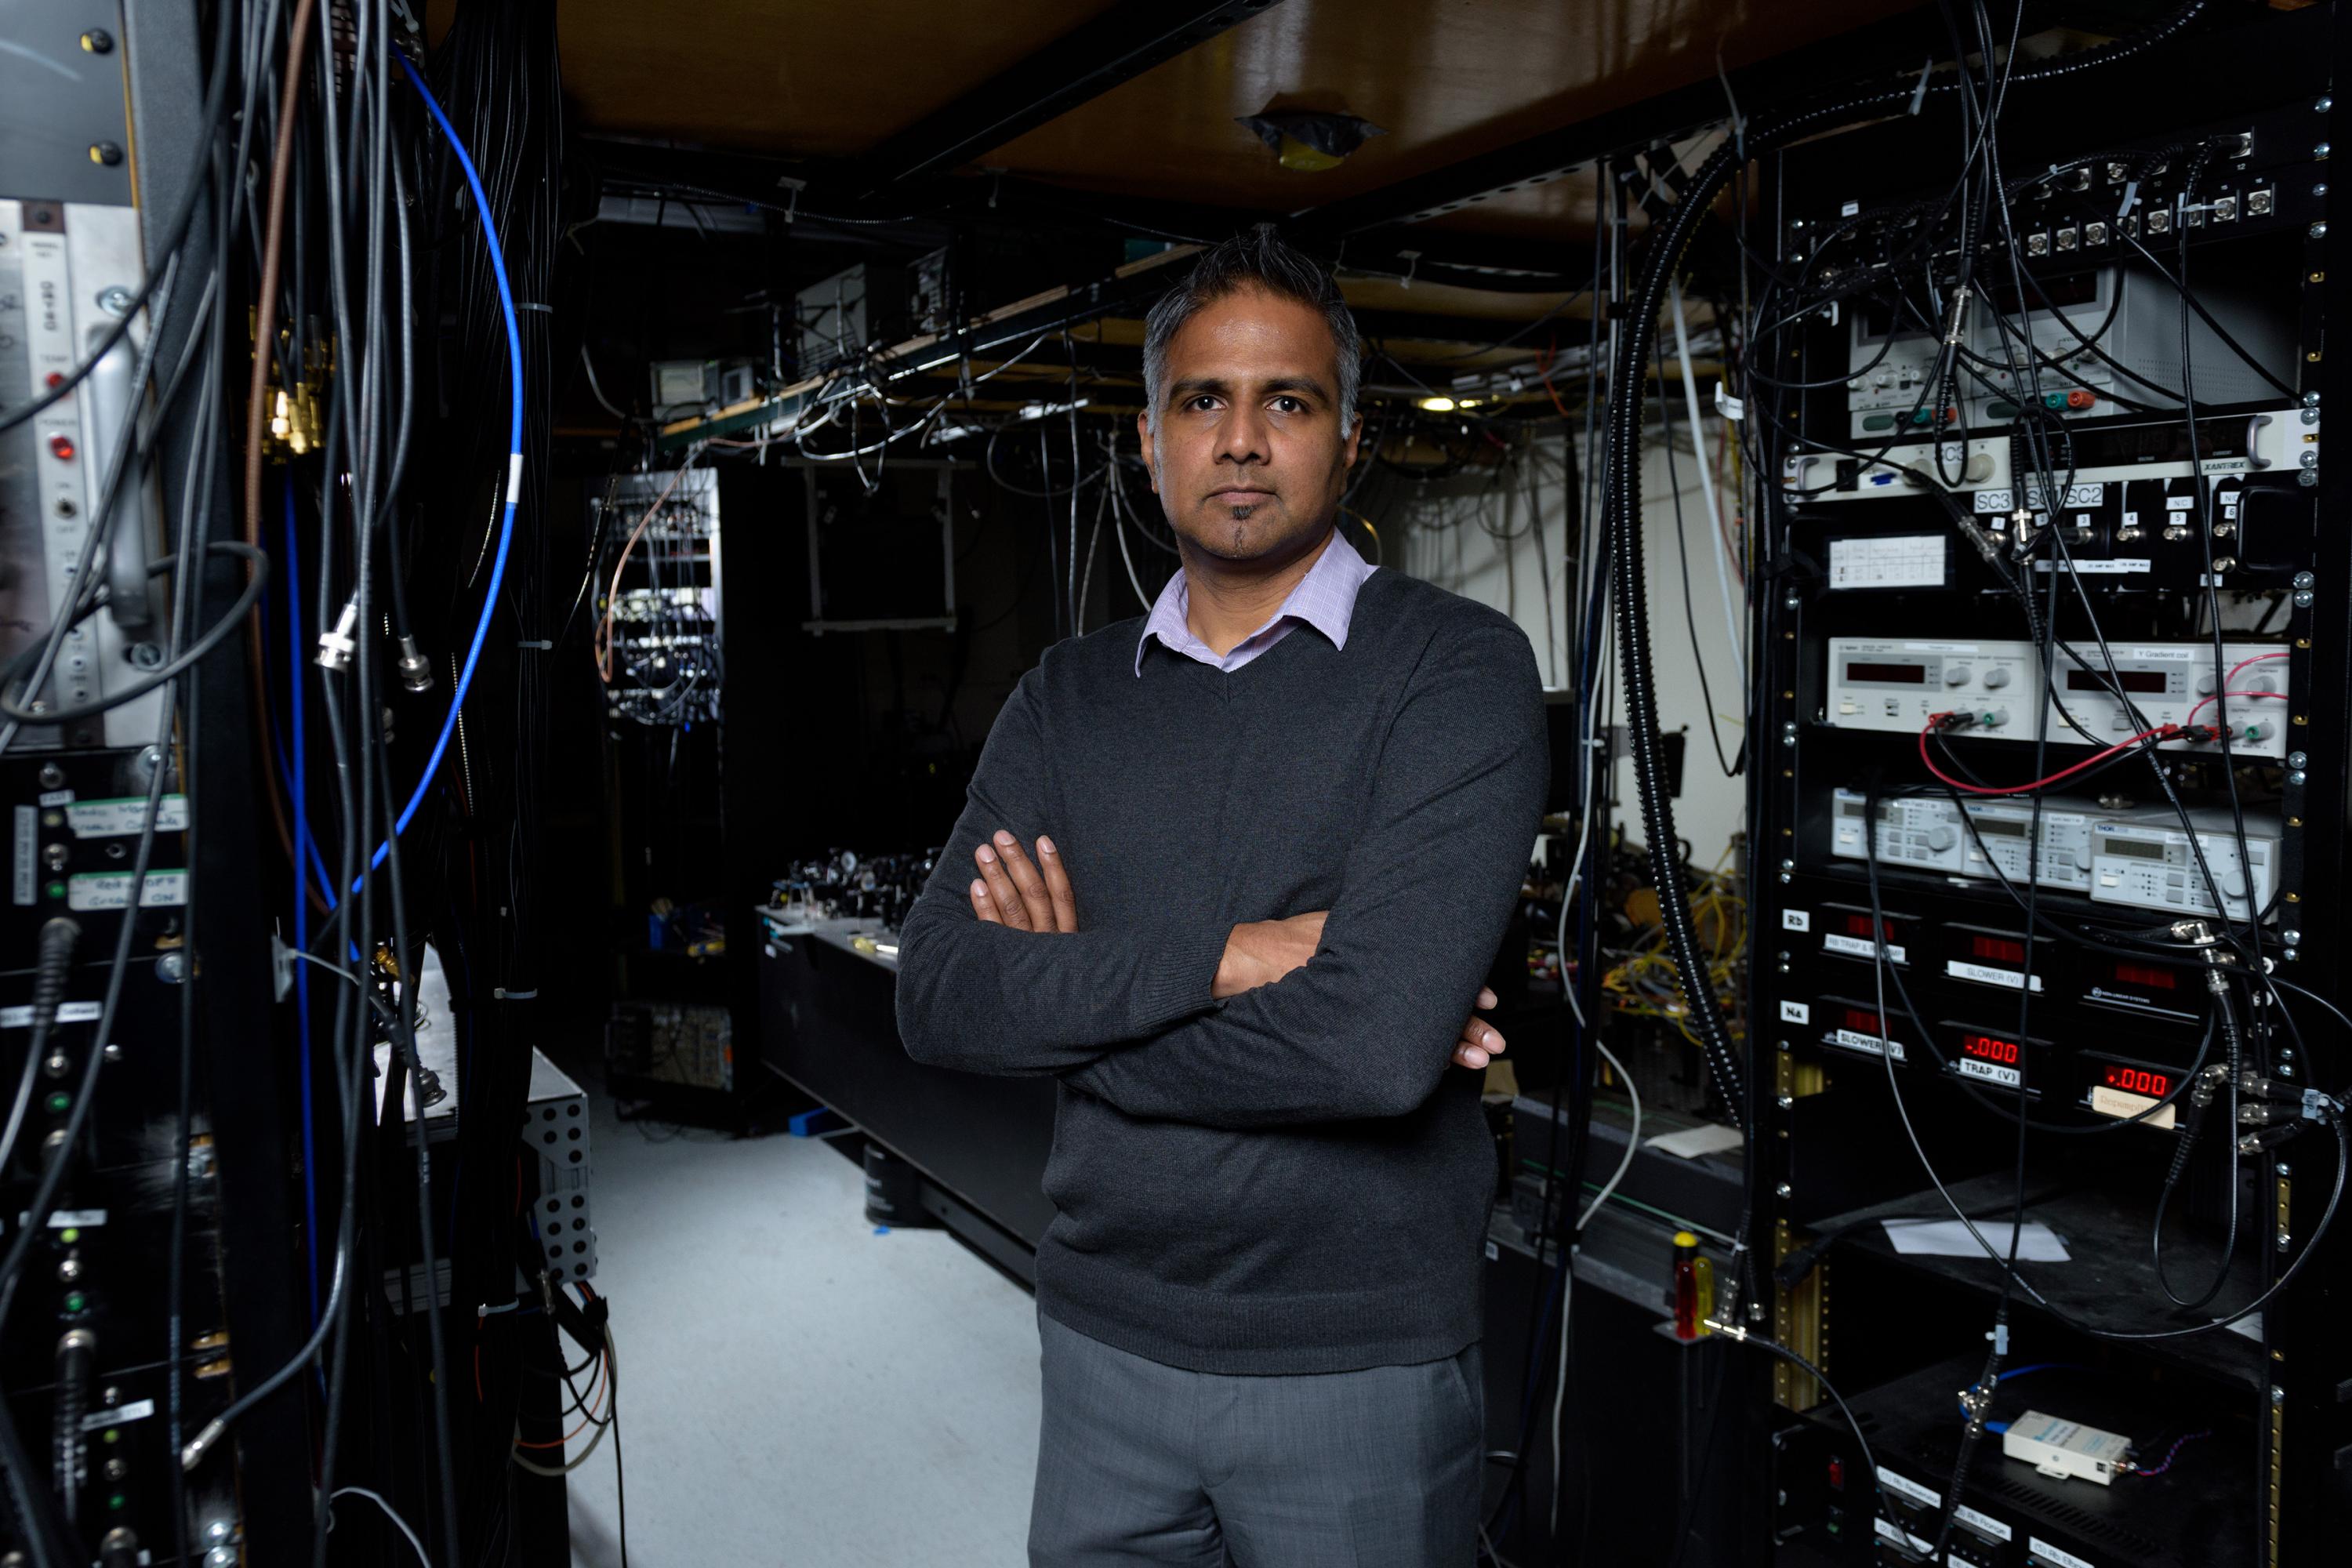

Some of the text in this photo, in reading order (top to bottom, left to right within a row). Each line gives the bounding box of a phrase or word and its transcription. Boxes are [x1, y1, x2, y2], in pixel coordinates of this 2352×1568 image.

[1976, 493, 2011, 510] SC3
[2066, 487, 2103, 505] SC2
[2146, 650, 2174, 659] Gradient
[1788, 915, 1803, 927] Rb
[1967, 967, 2020, 985] SLOWER (V)
[1841, 1033, 1882, 1049] SLOWER
[1965, 1062, 2016, 1082] TRAP (V)
